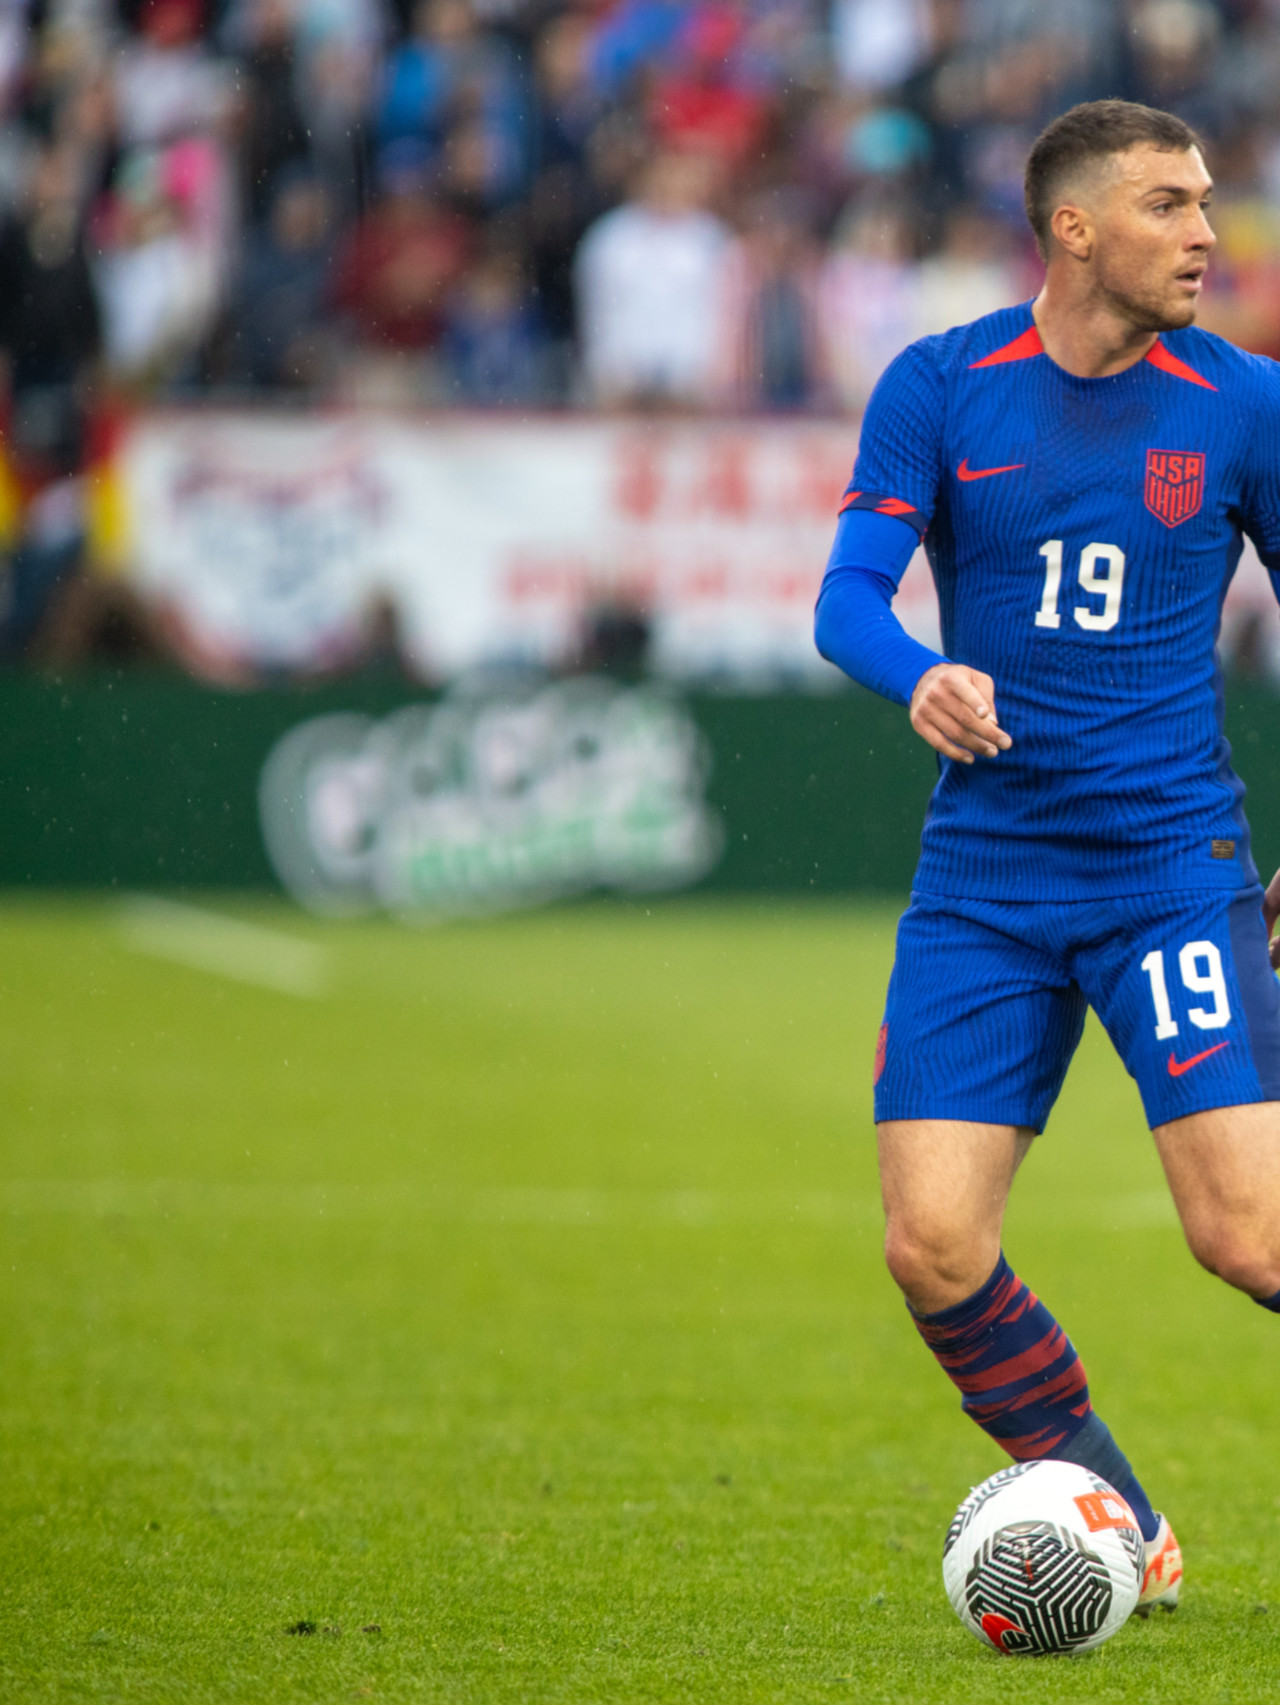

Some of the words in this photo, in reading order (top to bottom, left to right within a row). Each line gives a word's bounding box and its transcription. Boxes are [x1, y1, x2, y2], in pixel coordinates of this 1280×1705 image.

[1151, 454, 1200, 484] USA
[1034, 540, 1125, 632] 19
[1141, 940, 1232, 1040] 19
